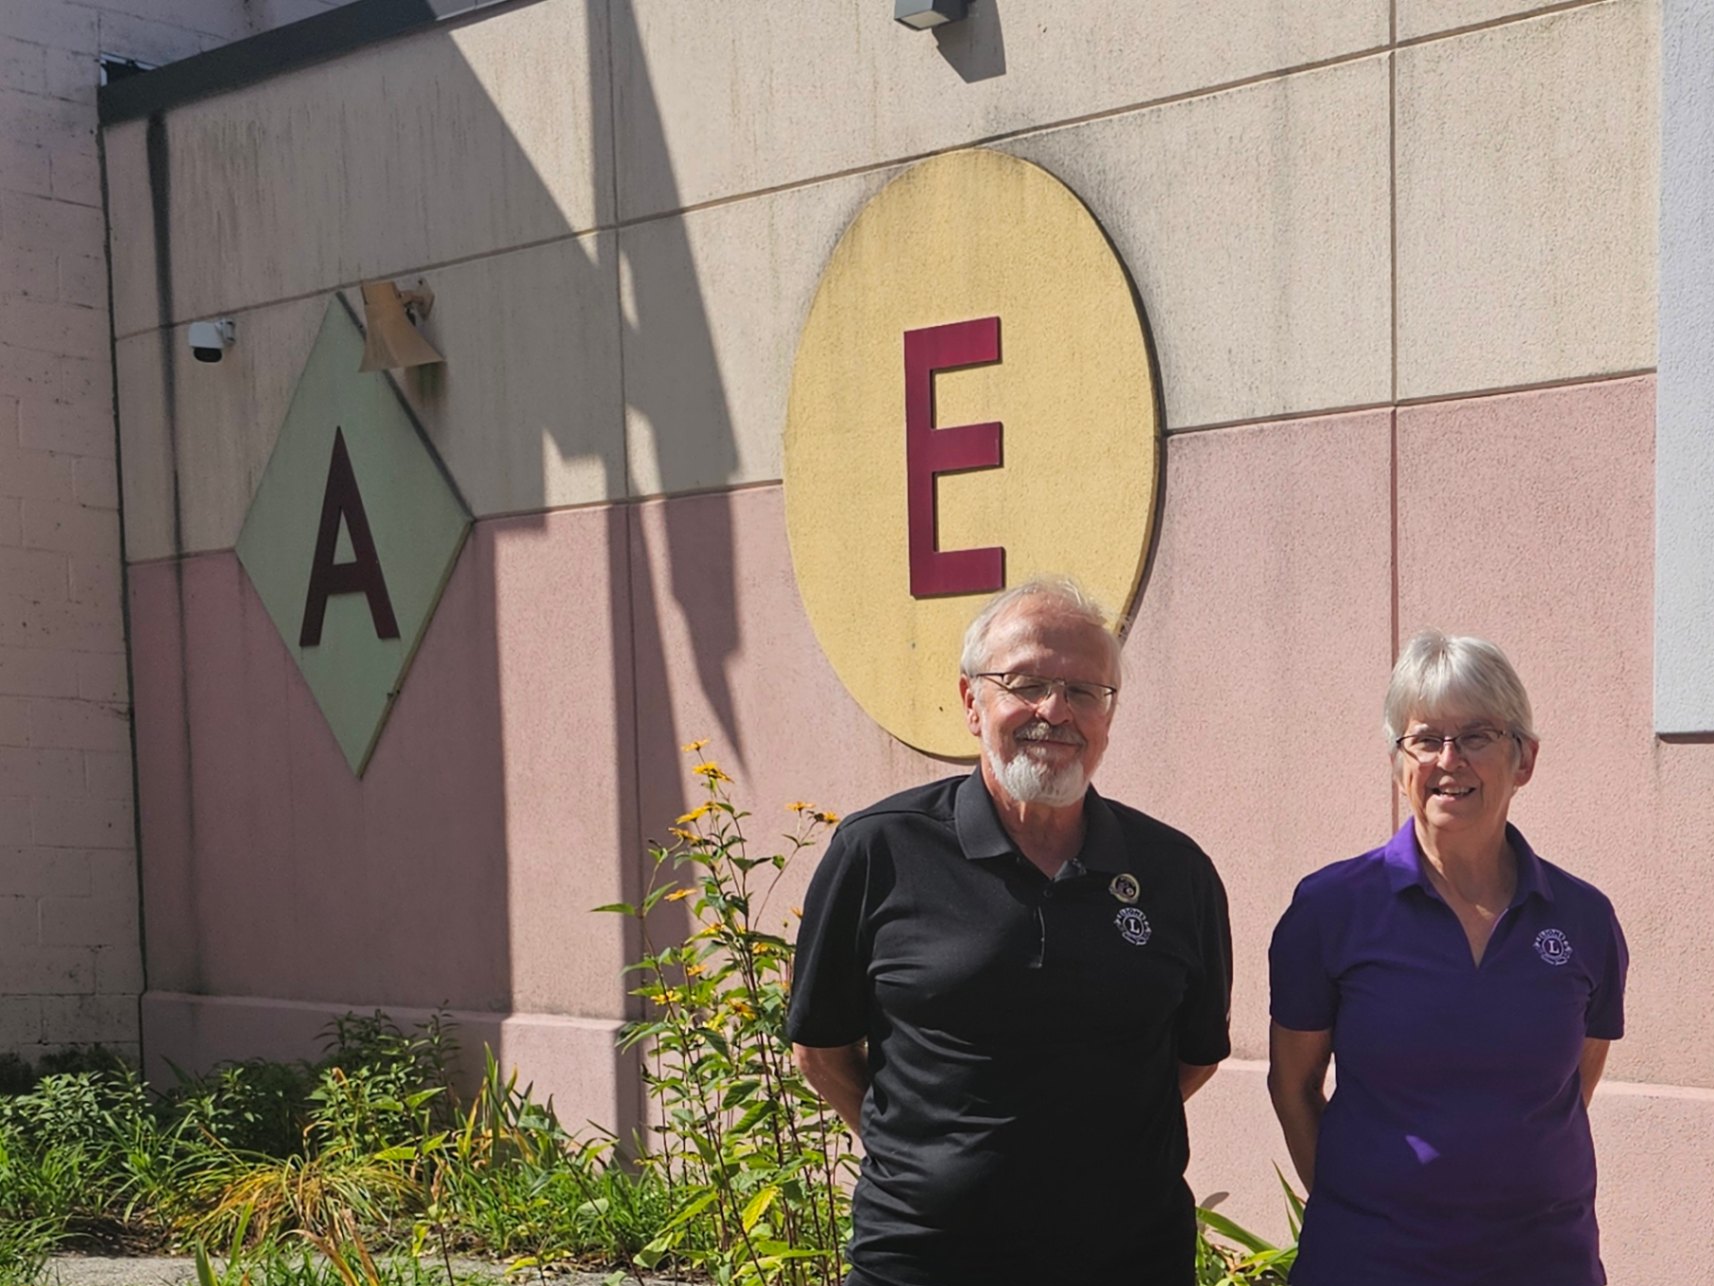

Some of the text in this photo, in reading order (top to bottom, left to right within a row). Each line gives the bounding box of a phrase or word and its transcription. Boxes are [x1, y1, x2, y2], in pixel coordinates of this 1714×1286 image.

[299, 425, 399, 647] A
[904, 316, 1004, 599] E
[1548, 940, 1560, 954] L
